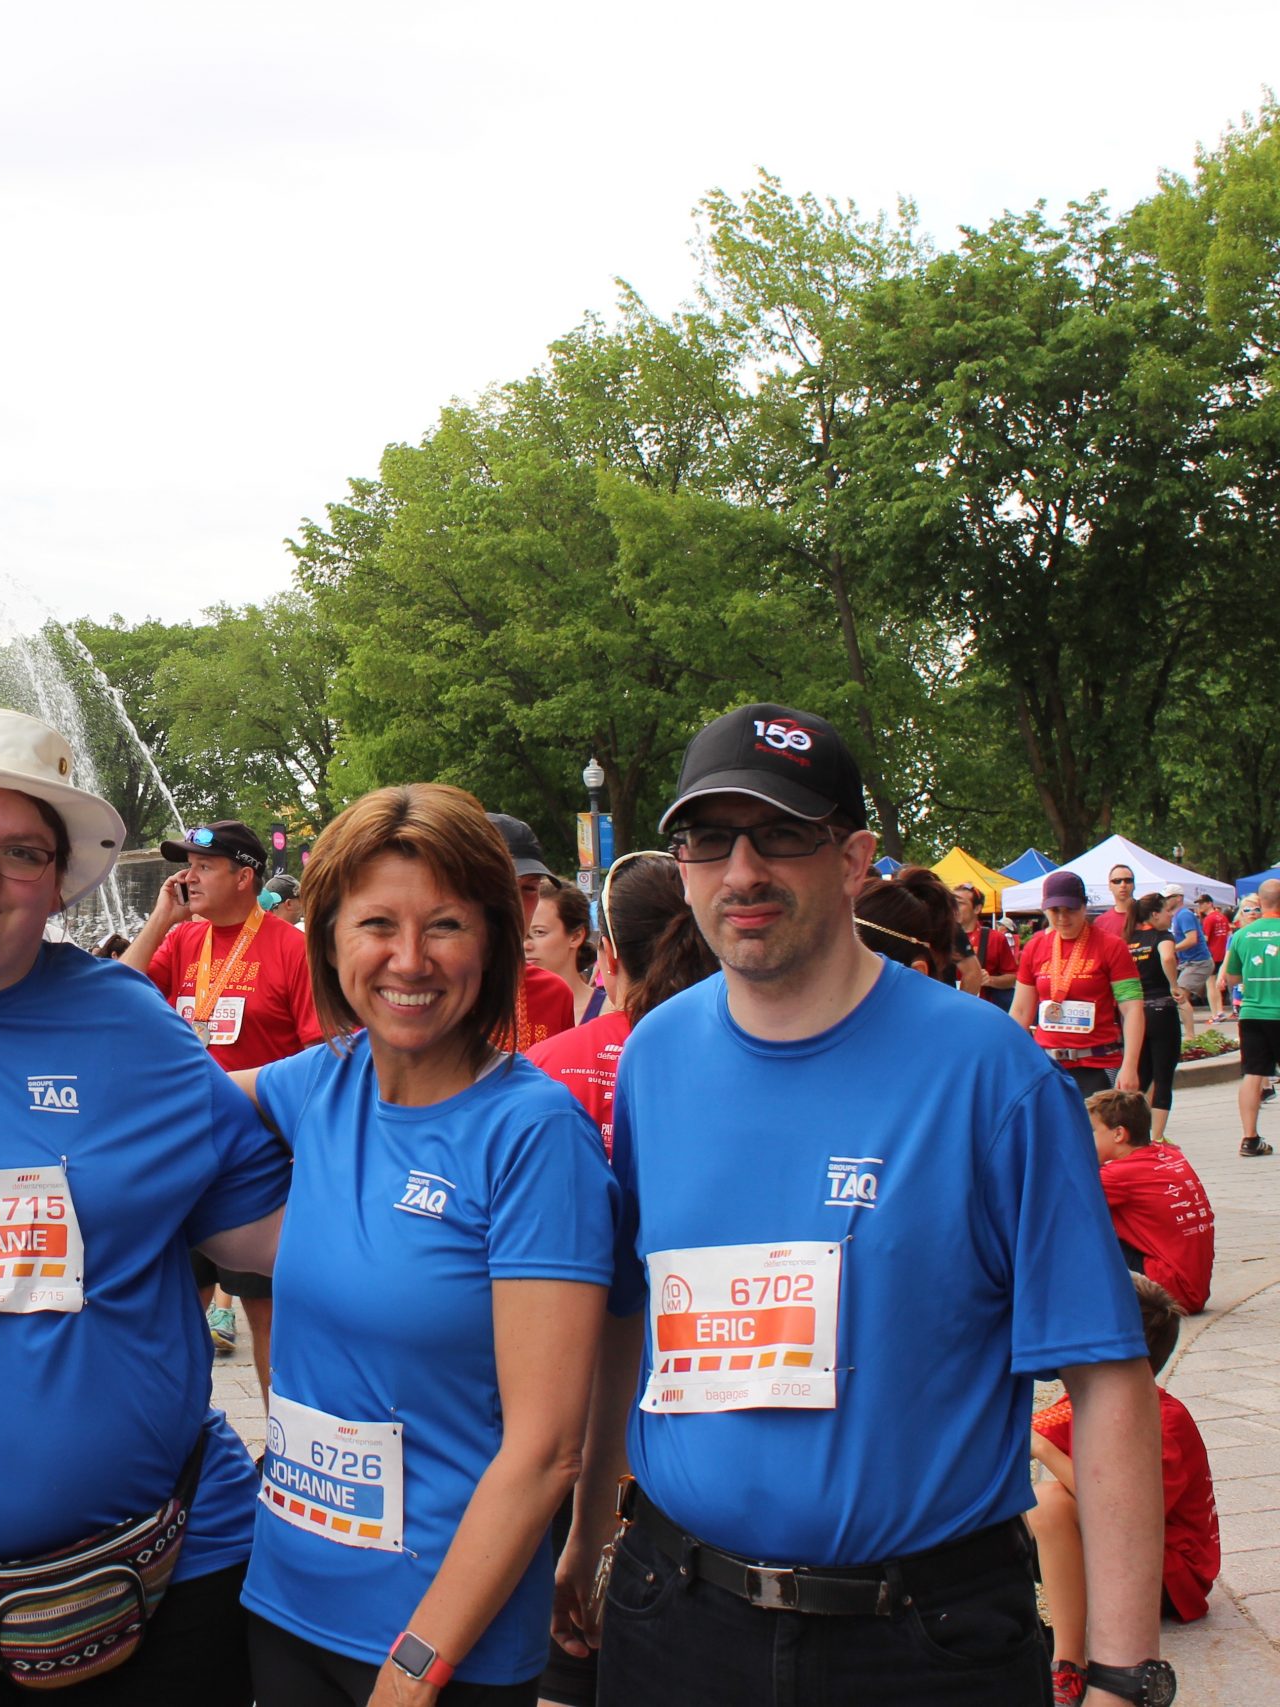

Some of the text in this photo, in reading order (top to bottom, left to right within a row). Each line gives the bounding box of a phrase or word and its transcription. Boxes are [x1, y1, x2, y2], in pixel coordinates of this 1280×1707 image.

[753, 720, 811, 751] 150
[211, 1008, 237, 1019] 559
[28, 1086, 79, 1108] TAQ
[828, 1164, 858, 1172] GROUPE
[400, 1183, 447, 1214] TAQ
[827, 1171, 877, 1201] TAQ
[29, 1291, 65, 1303] 6715
[665, 1283, 681, 1299] 10
[731, 1273, 815, 1306] 6702
[665, 1299, 682, 1312] KM
[696, 1314, 756, 1343] ÉRIC
[705, 1383, 812, 1403] bagages 6702
[311, 1440, 383, 1480] 6726
[269, 1458, 356, 1510] JOHANNE
